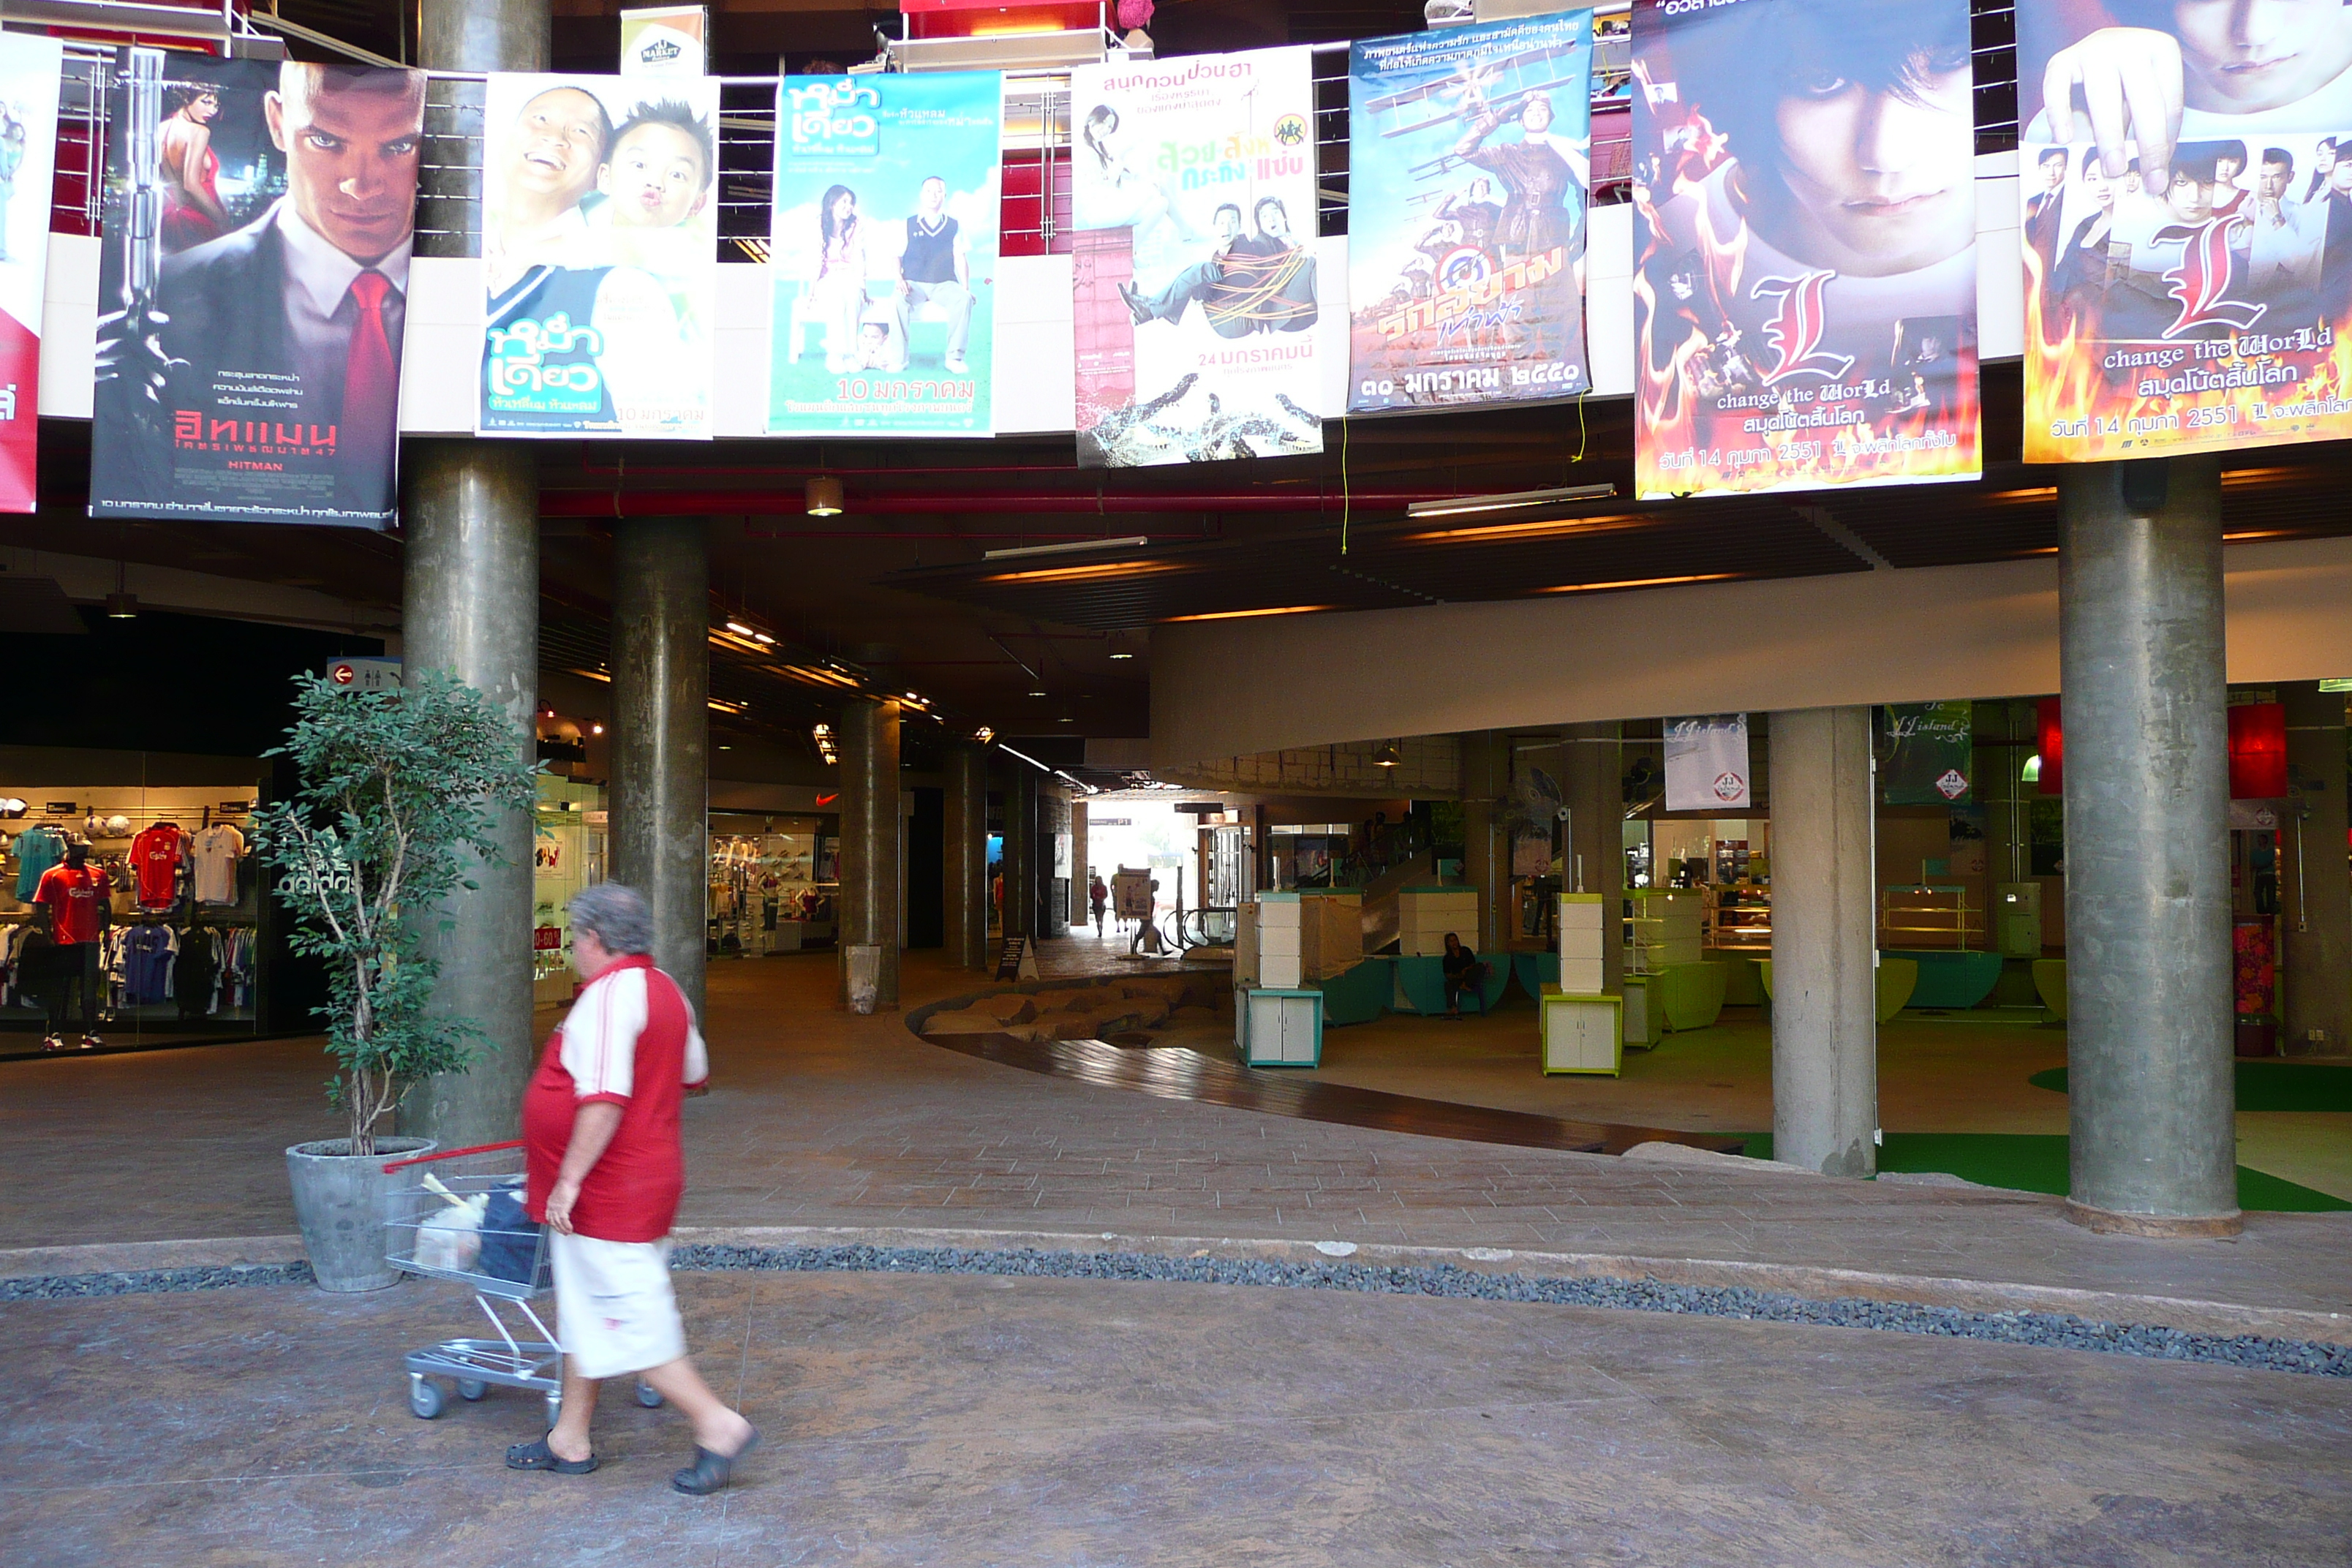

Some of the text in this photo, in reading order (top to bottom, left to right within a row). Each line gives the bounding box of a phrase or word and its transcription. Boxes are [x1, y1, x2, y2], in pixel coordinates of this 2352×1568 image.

[643, 48, 679, 58] MARKET
[792, 108, 875, 143] เดียว
[2148, 213, 2267, 339] L
[1377, 246, 1564, 342] รักสยาม
[1750, 269, 1855, 387] L
[1199, 334, 1313, 366] 24 มกราคมนี้
[2103, 348, 2185, 369] change
[2194, 339, 2231, 360] the
[491, 353, 599, 396] เดียว
[837, 379, 975, 400] 10 มกราคม
[1404, 367, 1500, 393] มกราคม
[2137, 358, 2297, 399] สมุดโน้ตสิ้นโลก
[618, 407, 704, 421] 10 มกราคม
[1717, 391, 1779, 409] change
[1787, 388, 1814, 403] the
[1743, 404, 1865, 436] สมุดโน้ตสิ้นโลก
[2051, 415, 2089, 437] วันที่
[2095, 417, 2120, 435] 14
[2127, 414, 2179, 437] กุมภา
[2186, 404, 2237, 428] 2551
[1659, 446, 1695, 470] วันที่
[1698, 448, 1722, 467] 14
[1727, 448, 1771, 468] กุมภา
[1777, 441, 1821, 461] 2551
[1852, 429, 1957, 454] จะพลิกโลกทั้งใบ
[228, 460, 283, 472] HITMAN
[101, 500, 113, 508] 10
[115, 500, 165, 510] มกราคม
